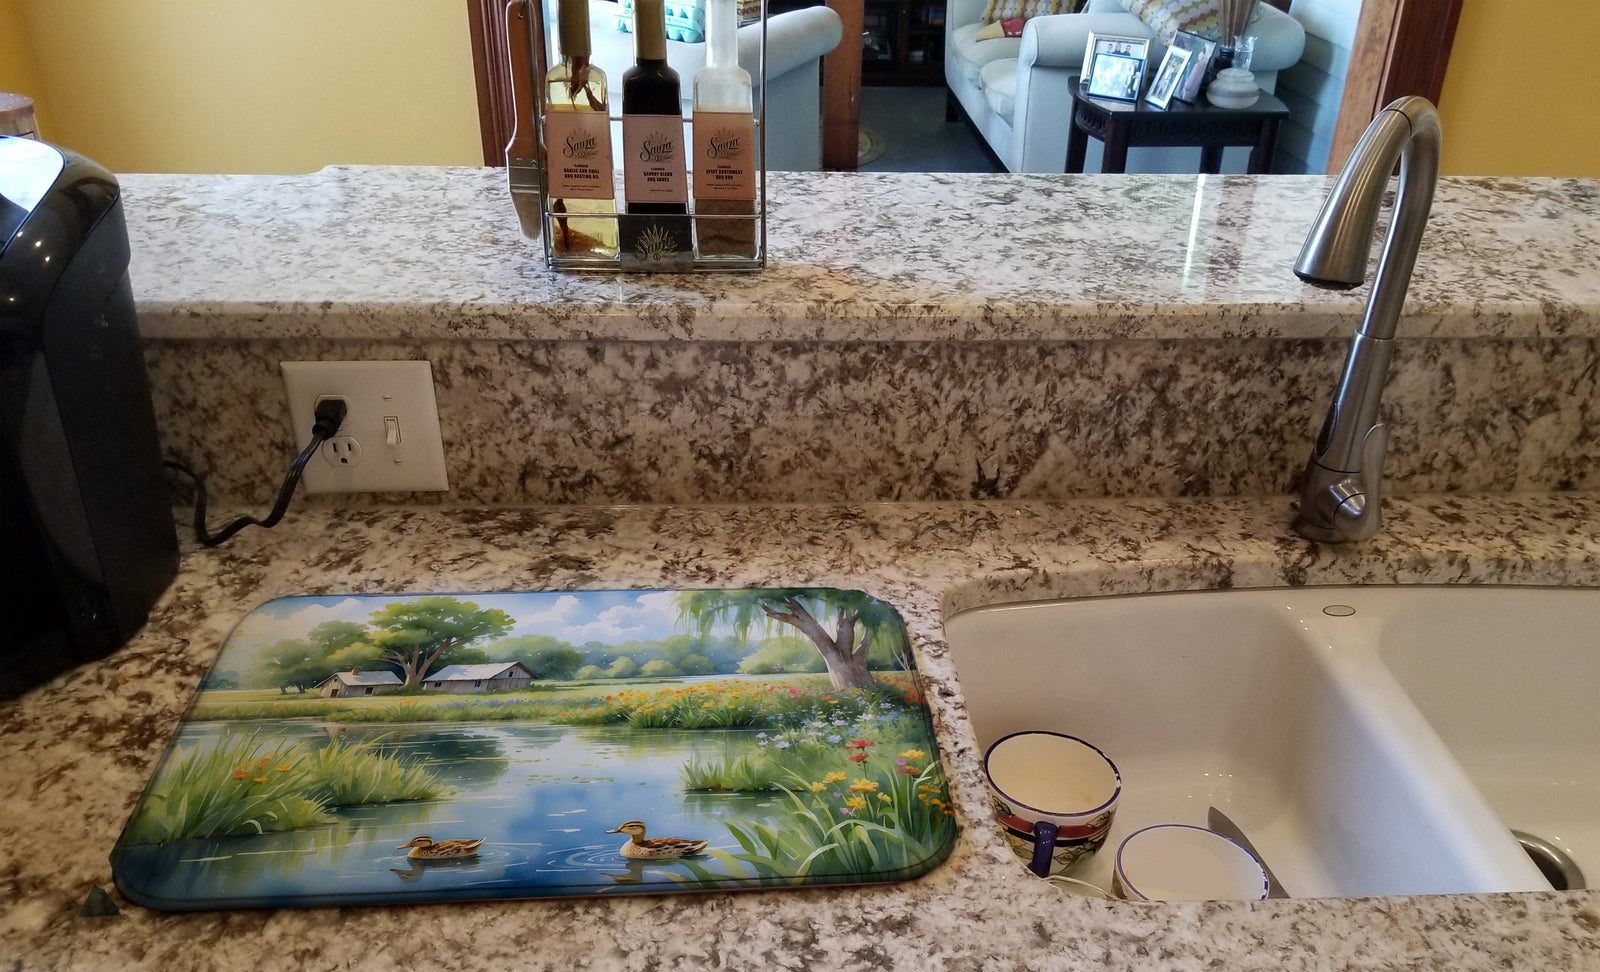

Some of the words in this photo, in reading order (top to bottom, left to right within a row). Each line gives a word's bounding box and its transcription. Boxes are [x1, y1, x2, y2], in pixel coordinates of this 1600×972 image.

[563, 136, 597, 158] Sauza
[640, 140, 673, 161] Sauza
[707, 137, 740, 159] Sauza
